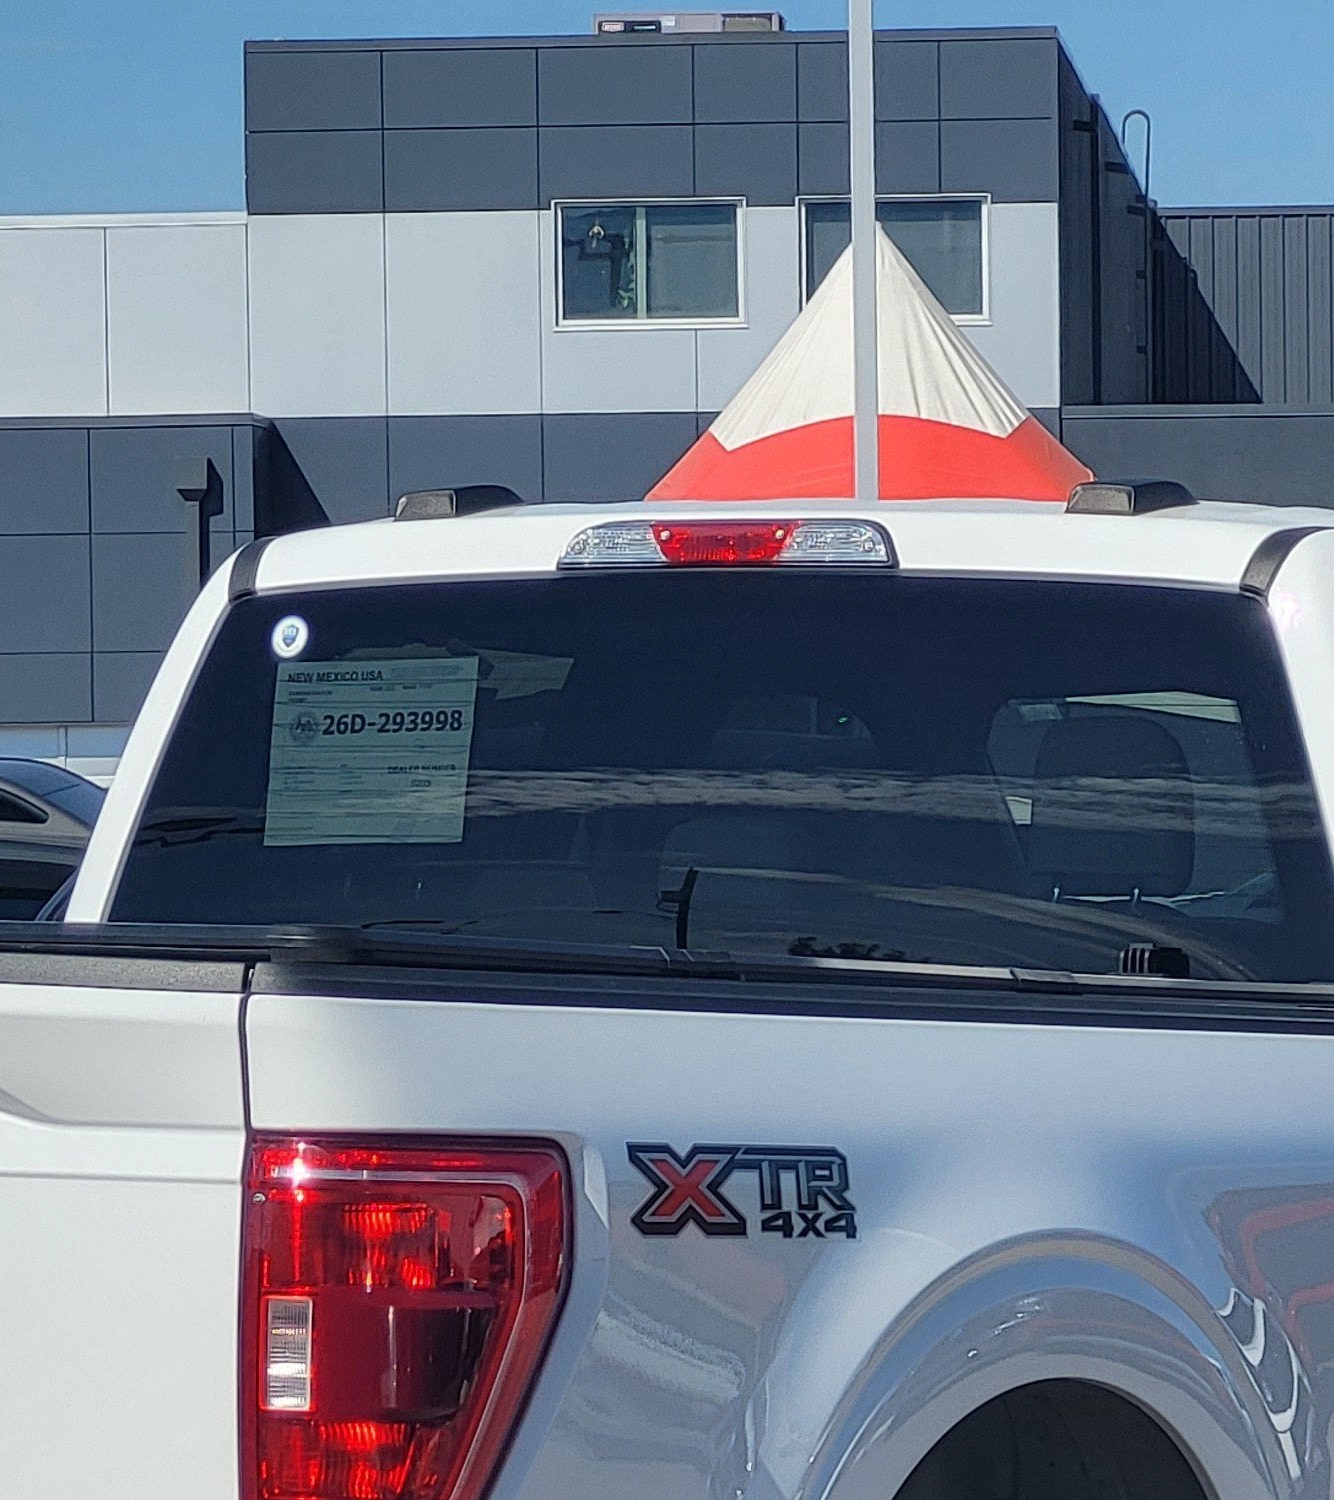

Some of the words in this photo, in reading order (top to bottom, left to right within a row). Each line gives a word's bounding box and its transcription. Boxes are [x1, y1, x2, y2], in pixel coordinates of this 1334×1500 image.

[288, 673, 313, 683] NEW
[316, 671, 359, 682] MEXICO
[361, 670, 383, 681] USA
[322, 710, 463, 736] 26D-293998
